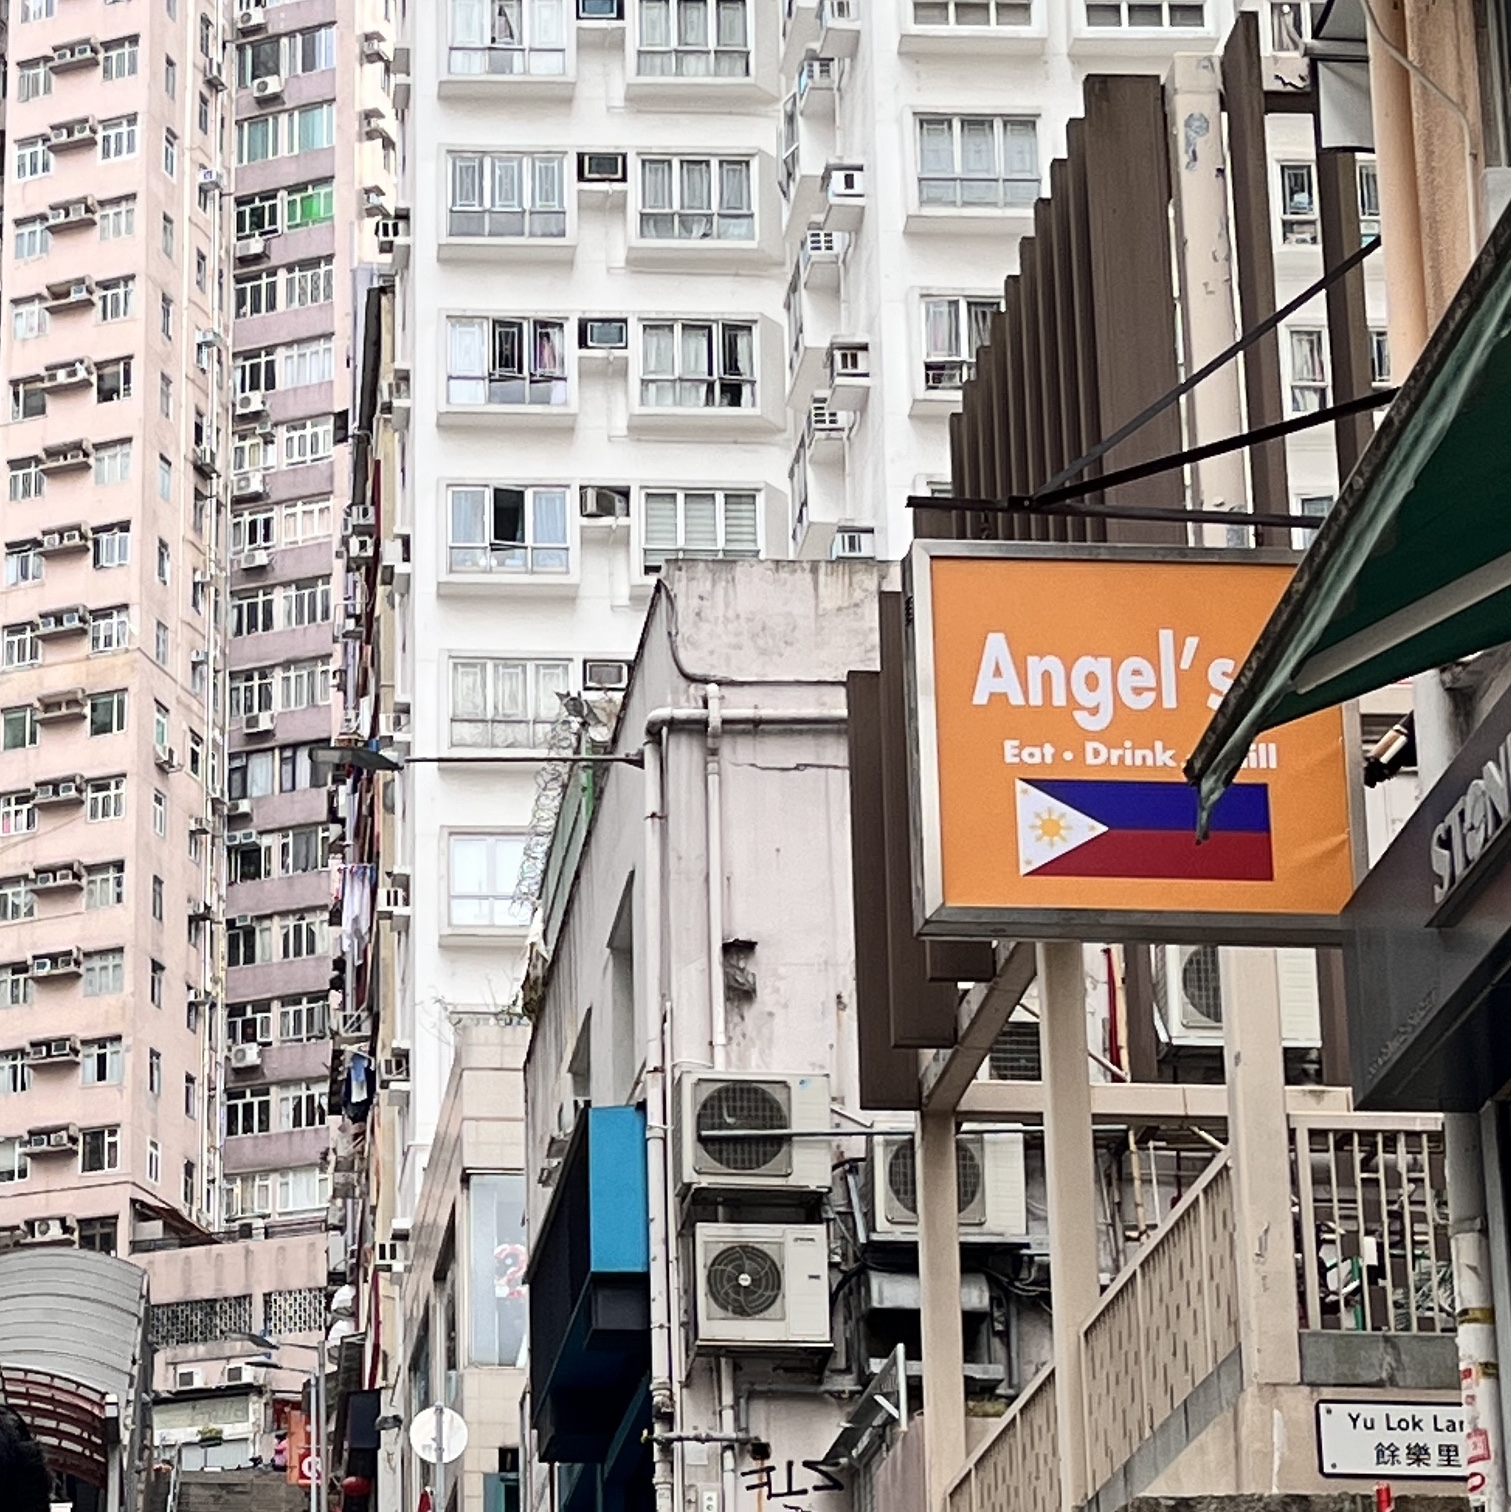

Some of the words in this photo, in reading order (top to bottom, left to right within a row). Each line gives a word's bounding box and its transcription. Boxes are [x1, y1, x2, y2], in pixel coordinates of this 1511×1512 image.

[972, 629, 1236, 732] Angel's
[1003, 740, 1055, 764] Eat
[1084, 740, 1176, 767] Drink
[1348, 1412, 1375, 1431] Yu
[1386, 1412, 1424, 1432] Lok
[1433, 1414, 1464, 1433] La
[1374, 1441, 1463, 1469] 餘樂里
